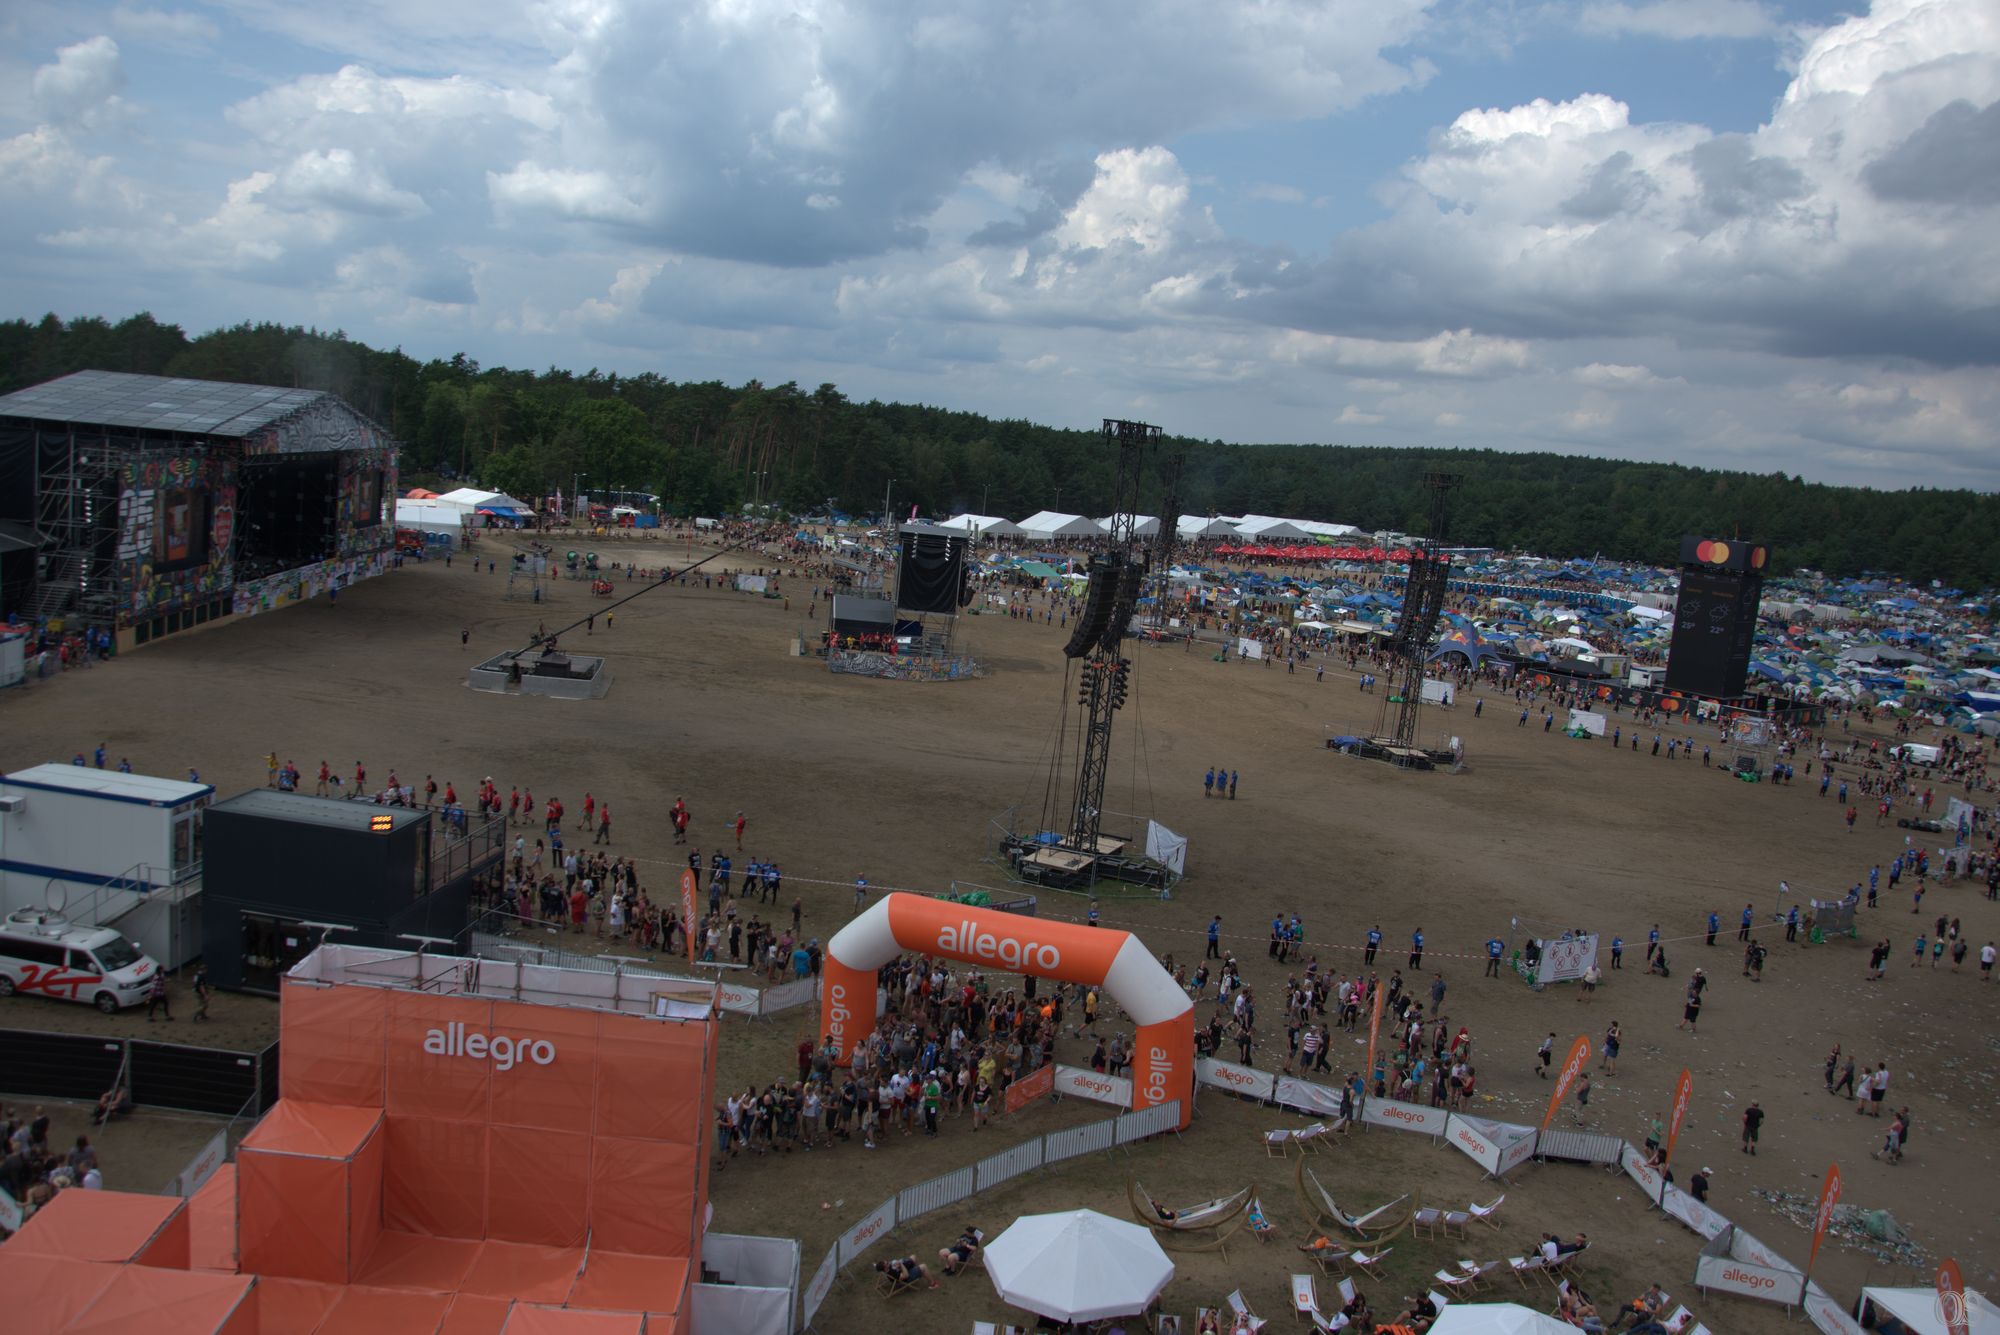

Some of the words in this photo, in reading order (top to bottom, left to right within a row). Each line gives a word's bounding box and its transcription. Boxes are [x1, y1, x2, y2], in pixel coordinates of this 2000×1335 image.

[937, 919, 1060, 970] allegro
[423, 1021, 556, 1071] allegro
[1143, 1046, 1173, 1107] alleg
[1215, 1068, 1254, 1086] allegro
[1557, 1044, 1587, 1098] allegro
[1073, 1076, 1112, 1094] allegro
[1383, 1106, 1425, 1123] allegro
[1458, 1129, 1485, 1154] allegro
[1631, 1158, 1653, 1185] allegro
[853, 1217, 883, 1245] allegro
[1723, 1268, 1775, 1289] allegro
